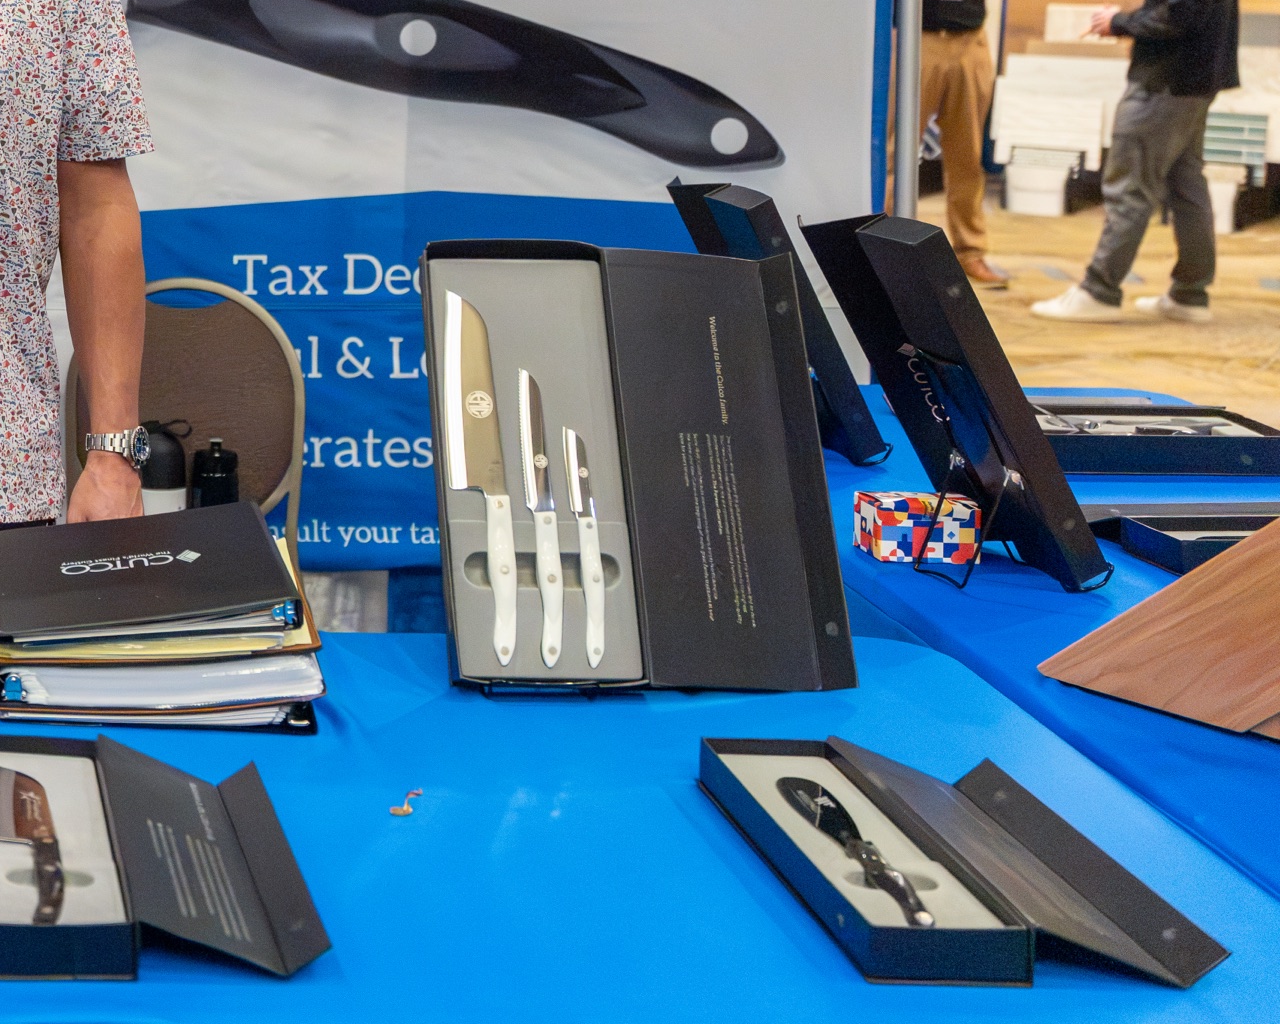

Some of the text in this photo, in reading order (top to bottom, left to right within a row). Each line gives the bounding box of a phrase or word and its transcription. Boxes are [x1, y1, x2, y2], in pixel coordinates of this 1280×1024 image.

[232, 253, 329, 296] Tax
[708, 316, 719, 351] Welcome
[336, 336, 375, 379] &
[713, 352, 720, 360] to
[714, 361, 722, 374] the
[716, 375, 724, 398] Cutco
[303, 429, 434, 468] rates
[338, 525, 403, 547] your
[410, 522, 440, 545] ta
